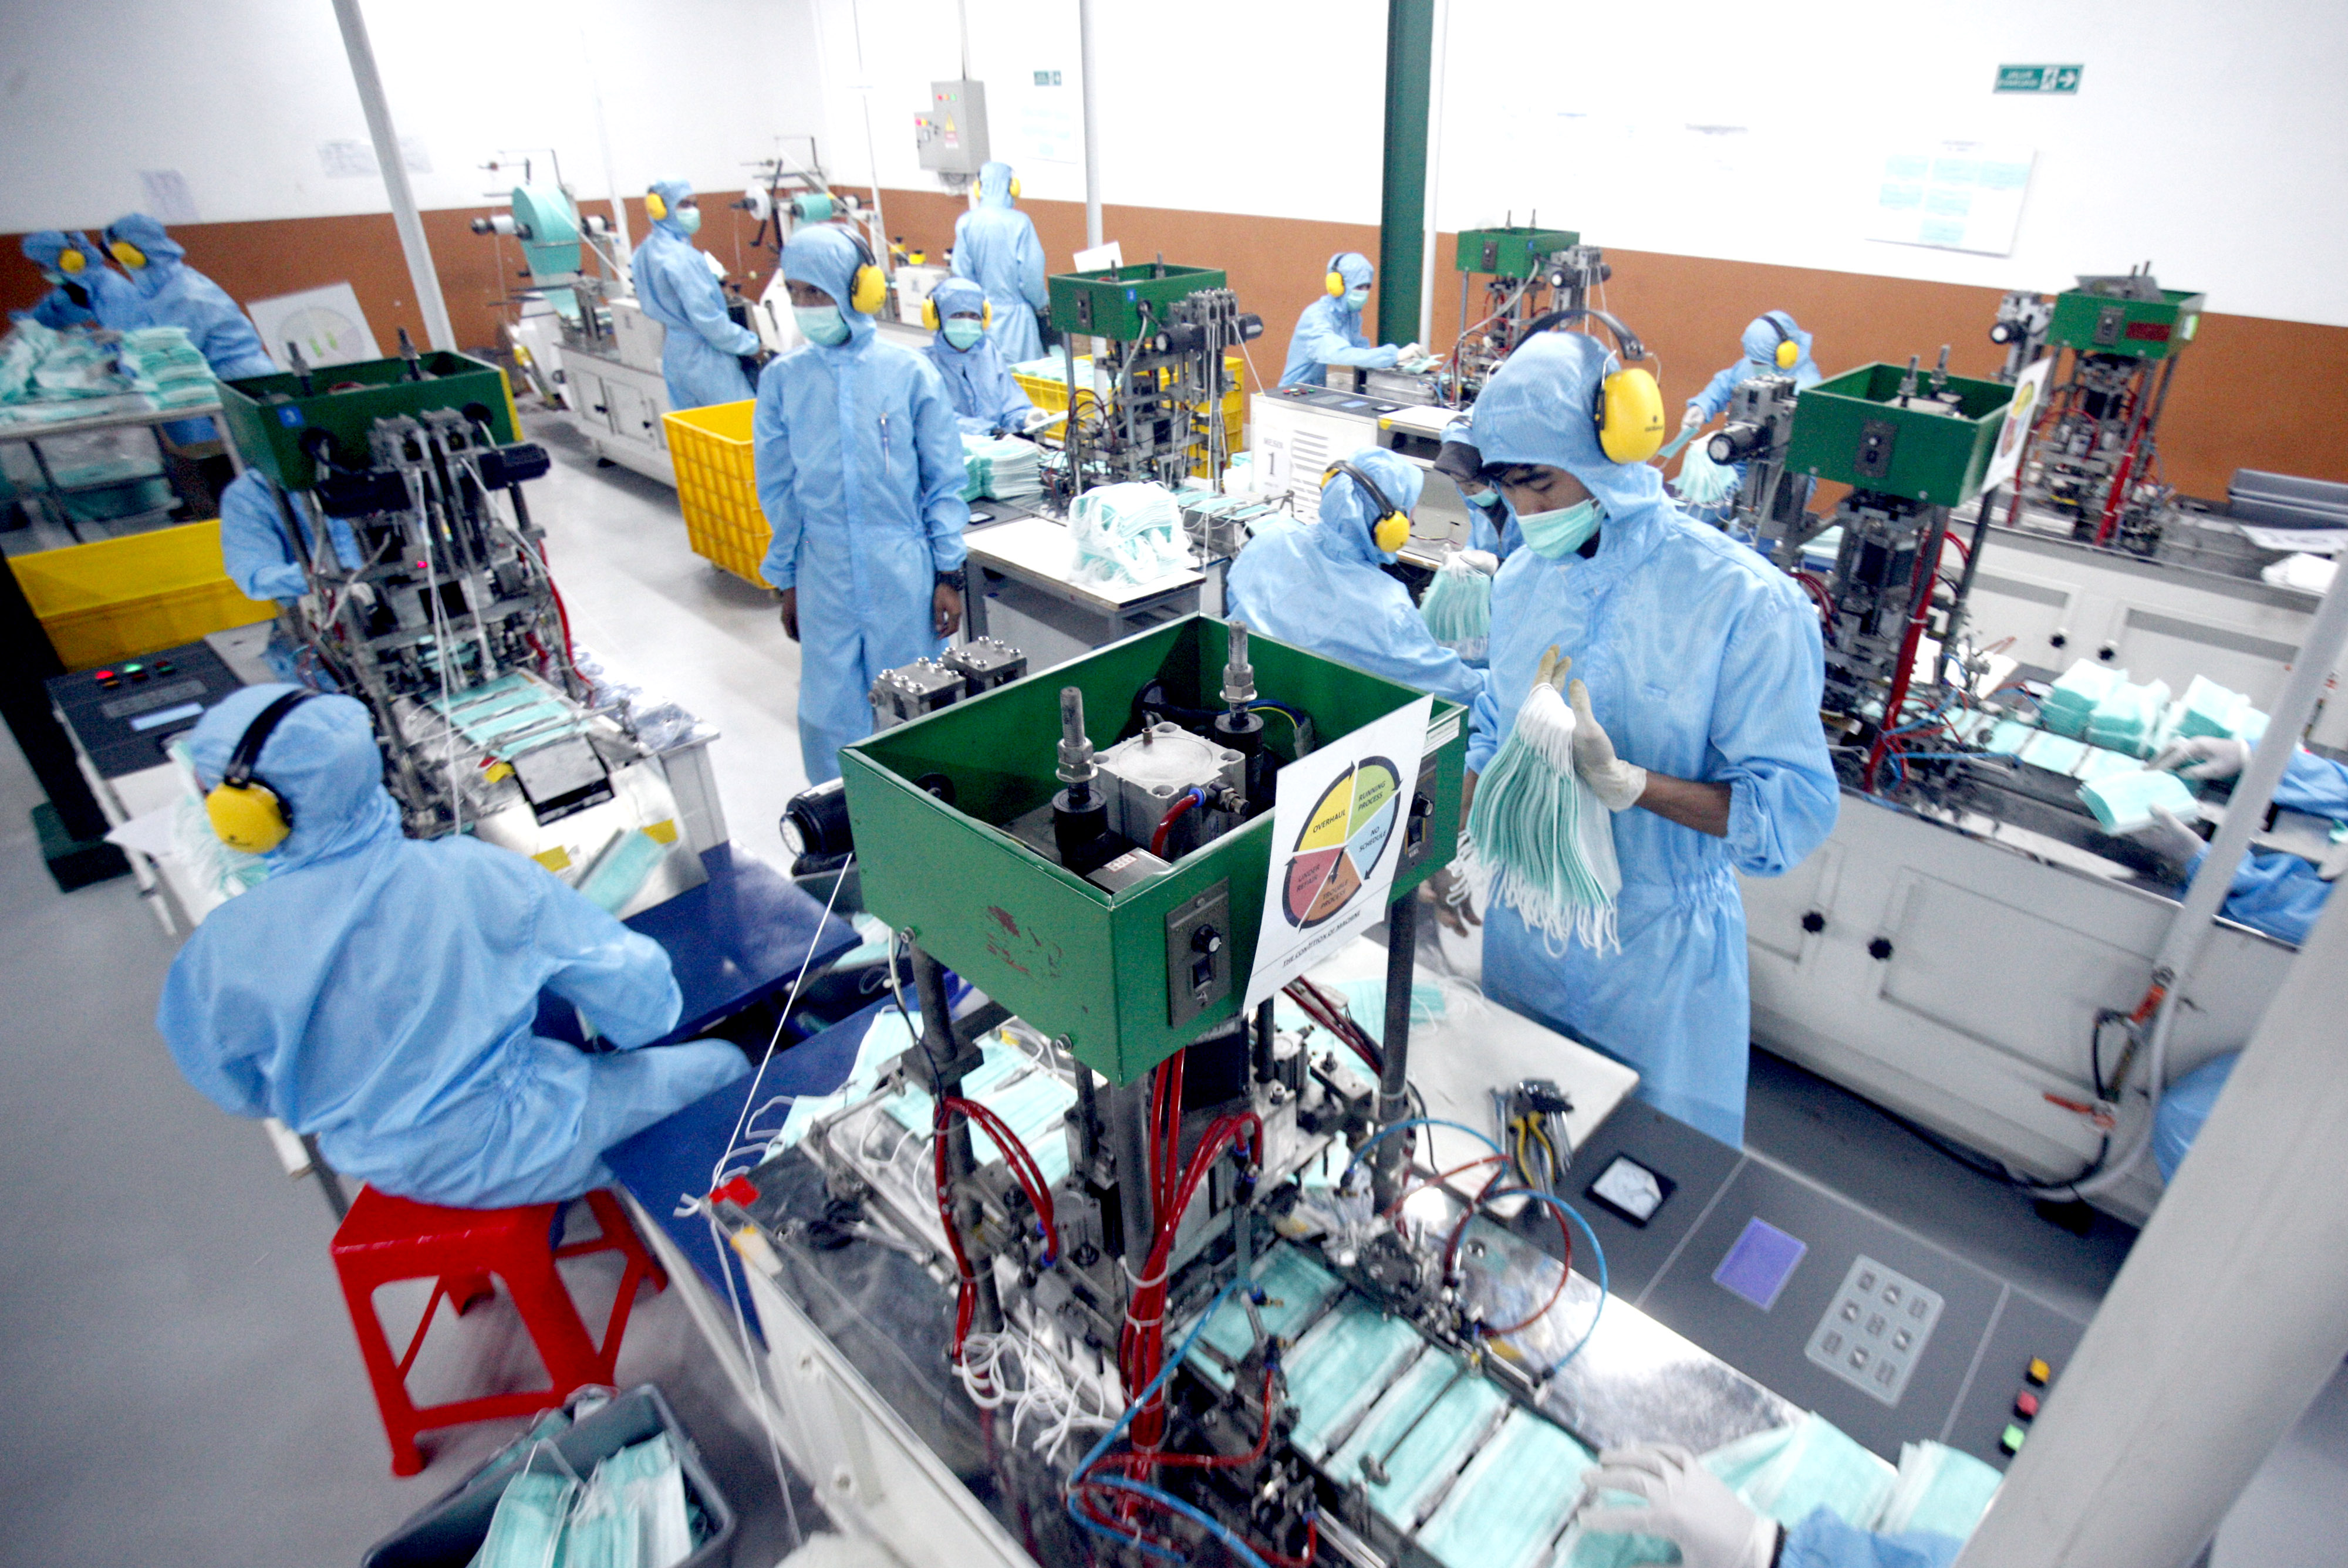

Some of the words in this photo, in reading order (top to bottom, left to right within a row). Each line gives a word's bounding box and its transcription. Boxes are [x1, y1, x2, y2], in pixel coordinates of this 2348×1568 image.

[1268, 452, 1276, 477] 1
[1358, 780, 1386, 802] RUNNING
[1358, 792, 1383, 812] PROCESS
[1313, 809, 1346, 833] OVERHAUL
[1370, 826, 1380, 836] NO
[1359, 830, 1386, 852] SCHEDULE
[1296, 874, 1318, 893] REPAIR
[1298, 864, 1320, 882] UNDER
[1320, 890, 1346, 909] PROCESS
[1323, 879, 1349, 900] TROUBLE
[1283, 956, 1295, 968] THE
[1327, 928, 1336, 937] OF
[1336, 910, 1361, 931] MACHINE
